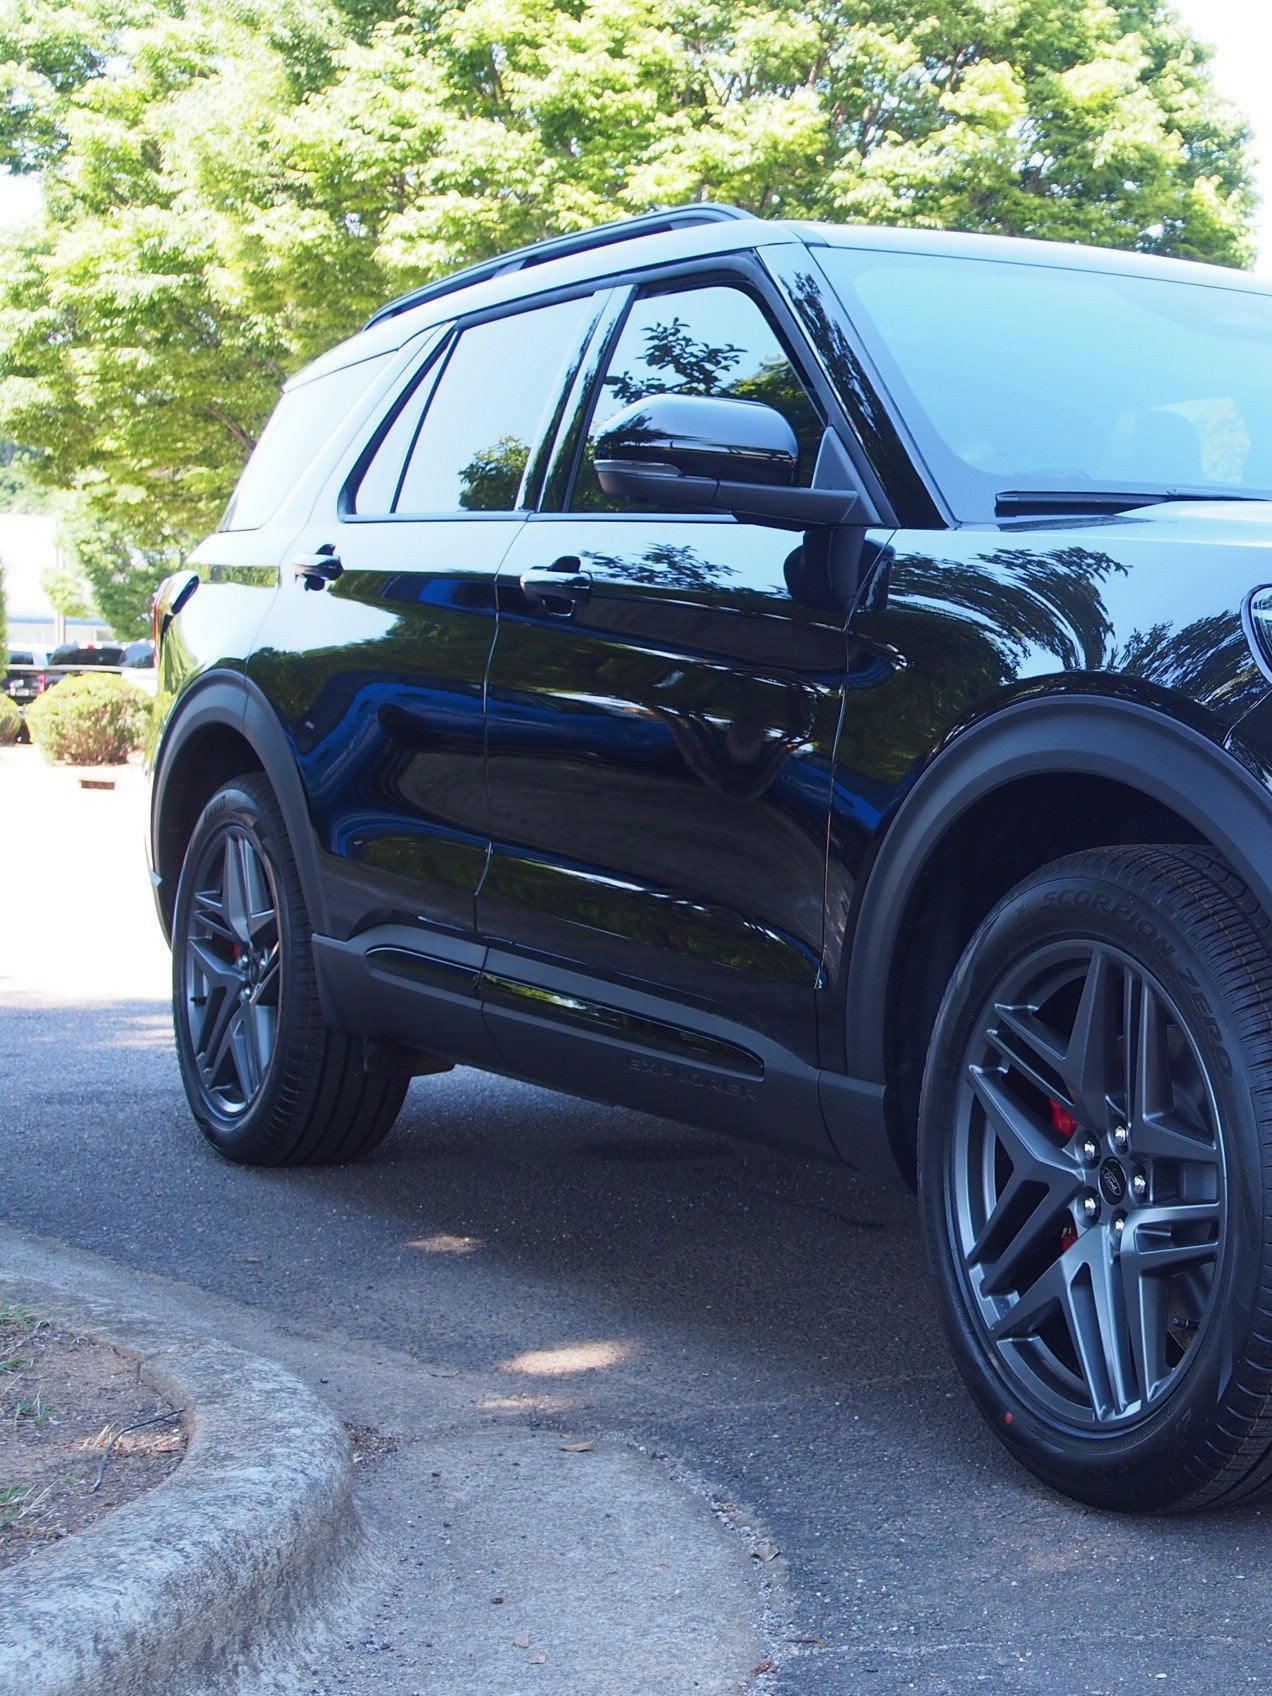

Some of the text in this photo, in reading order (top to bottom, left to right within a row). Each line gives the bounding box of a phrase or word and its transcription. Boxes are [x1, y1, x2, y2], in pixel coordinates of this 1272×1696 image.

[1039, 889, 1233, 1077] SCORPION ZERO
[627, 1058, 758, 1102] EXPLORER
[1104, 1171, 1118, 1192] Ford
